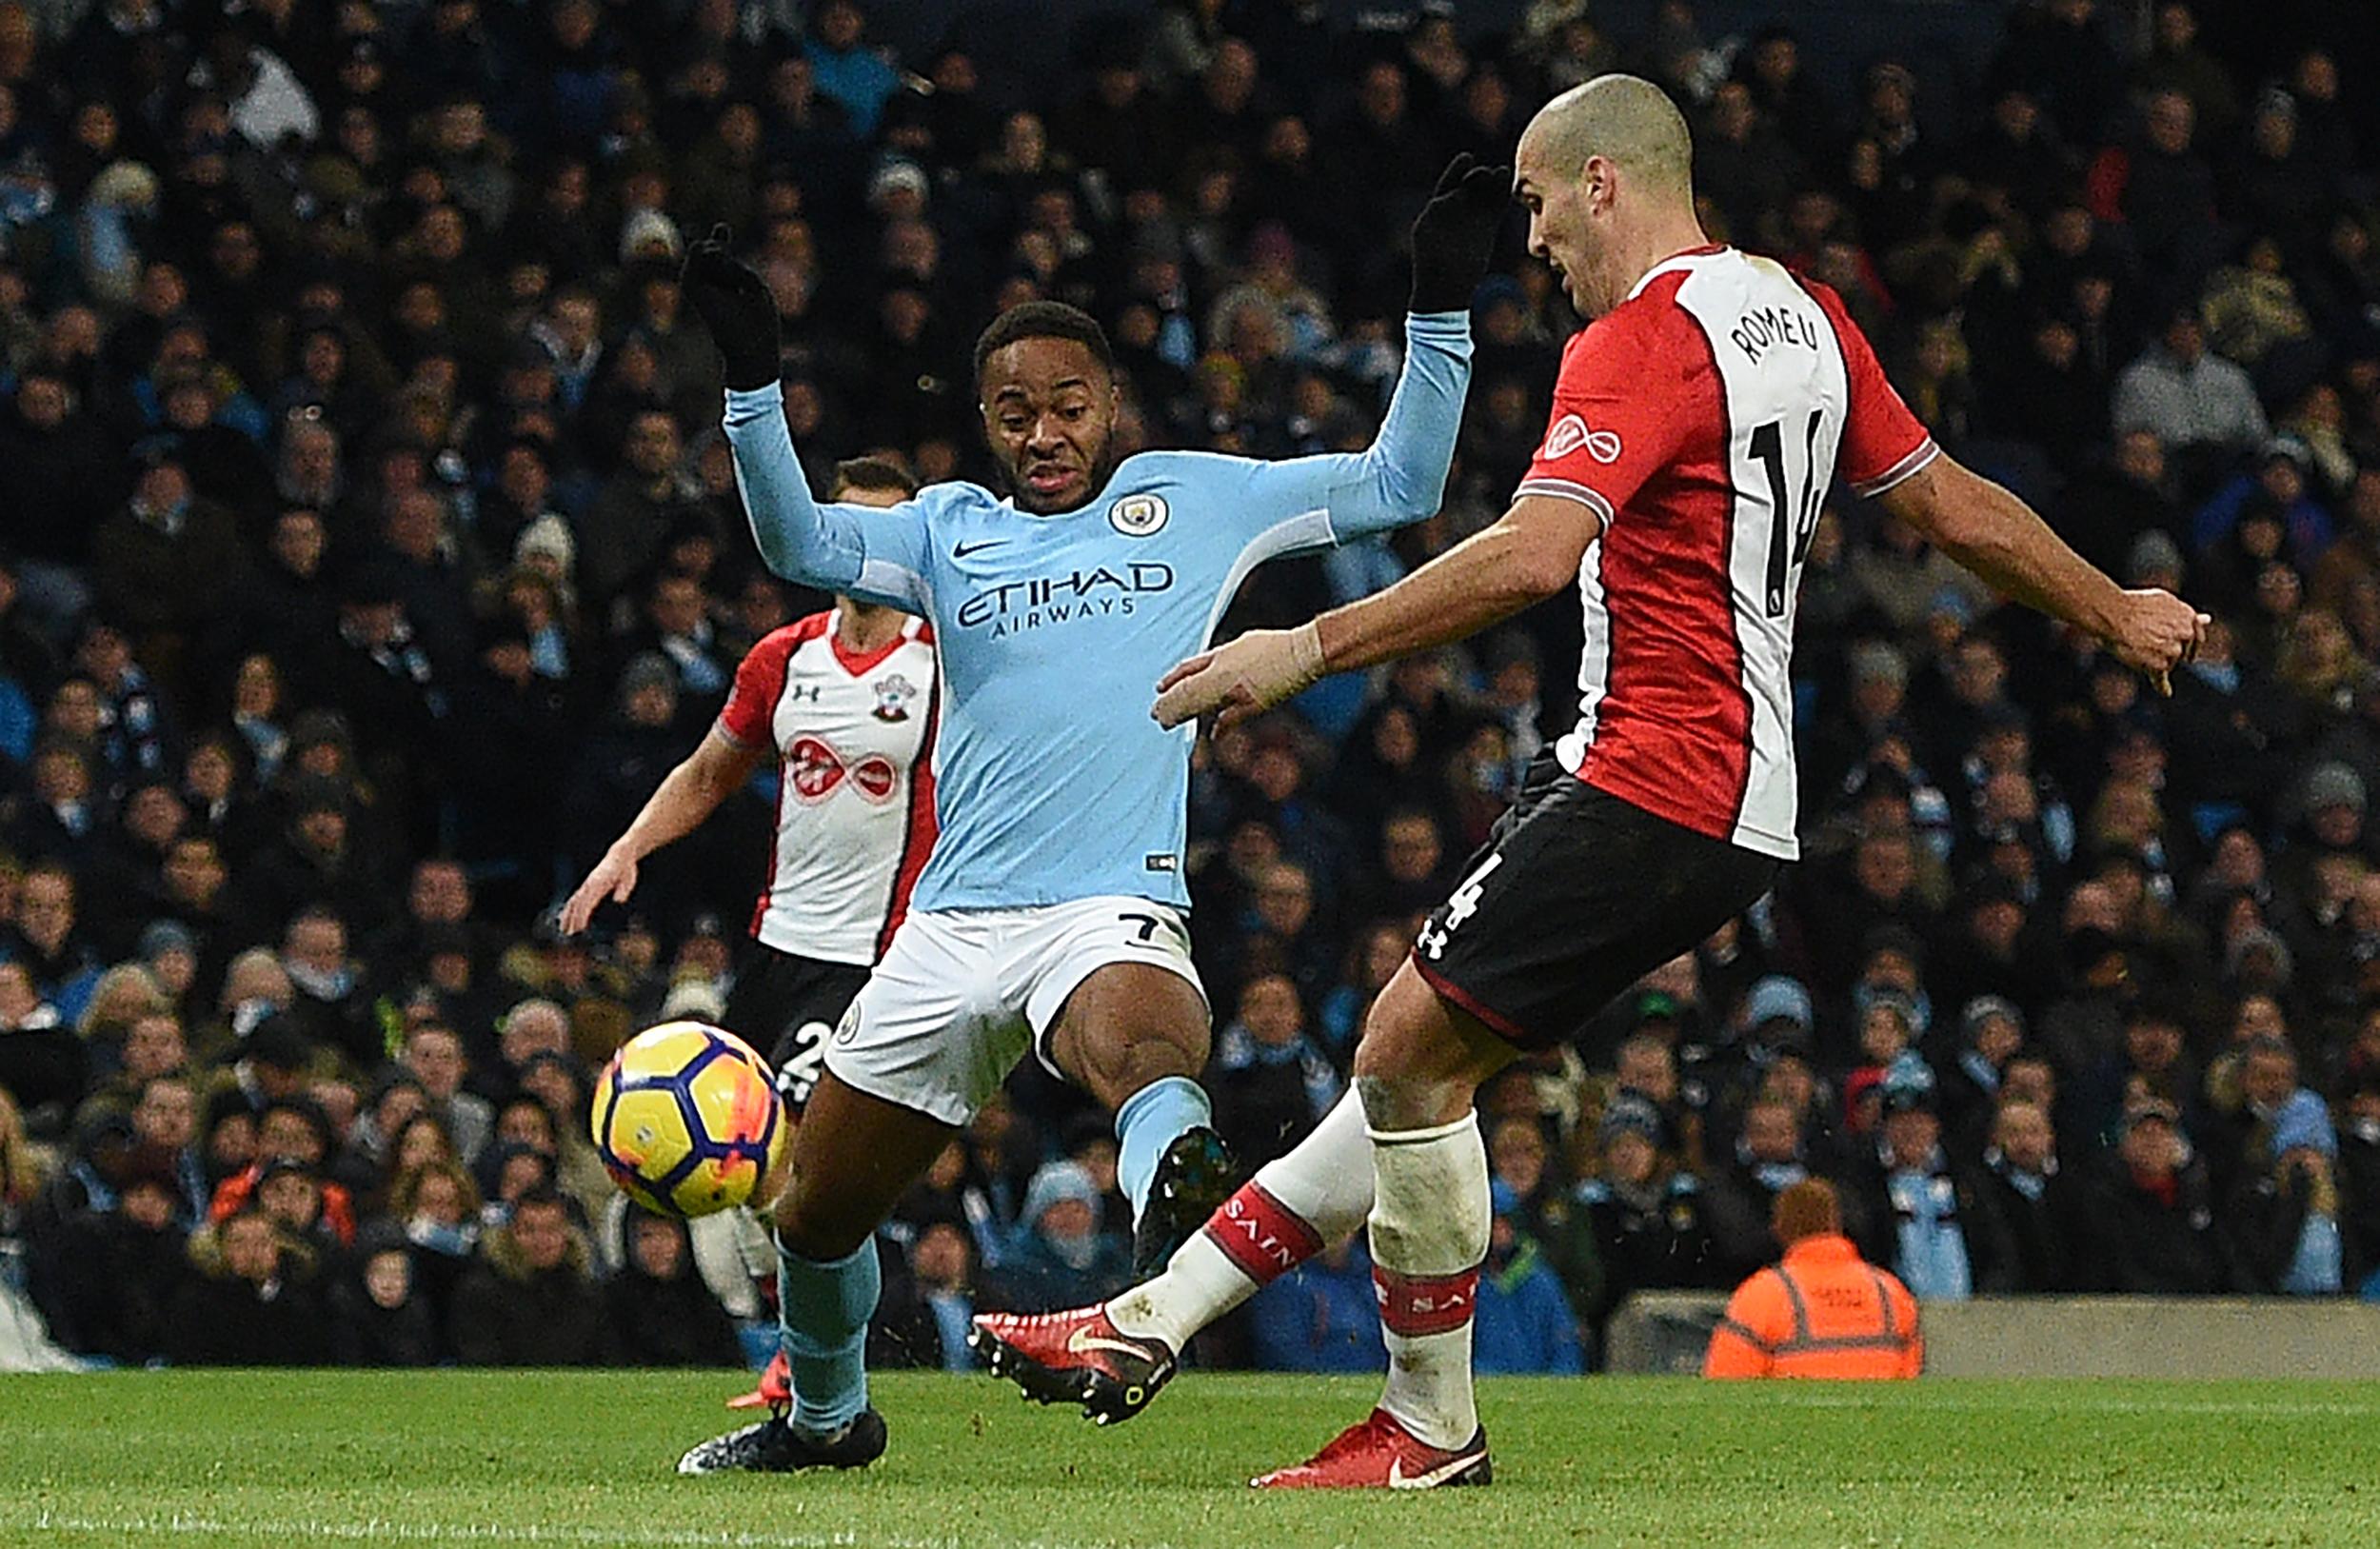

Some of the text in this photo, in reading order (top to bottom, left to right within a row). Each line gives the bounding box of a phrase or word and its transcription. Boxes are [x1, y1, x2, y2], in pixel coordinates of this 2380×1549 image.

[1731, 306, 1819, 364] ROMEU
[1747, 409, 1823, 619] 14
[958, 564, 1173, 626] ETIHAD
[991, 596, 1134, 639] AIRWAYS
[1118, 914, 1159, 941] 7
[783, 1022, 832, 1082] 2
